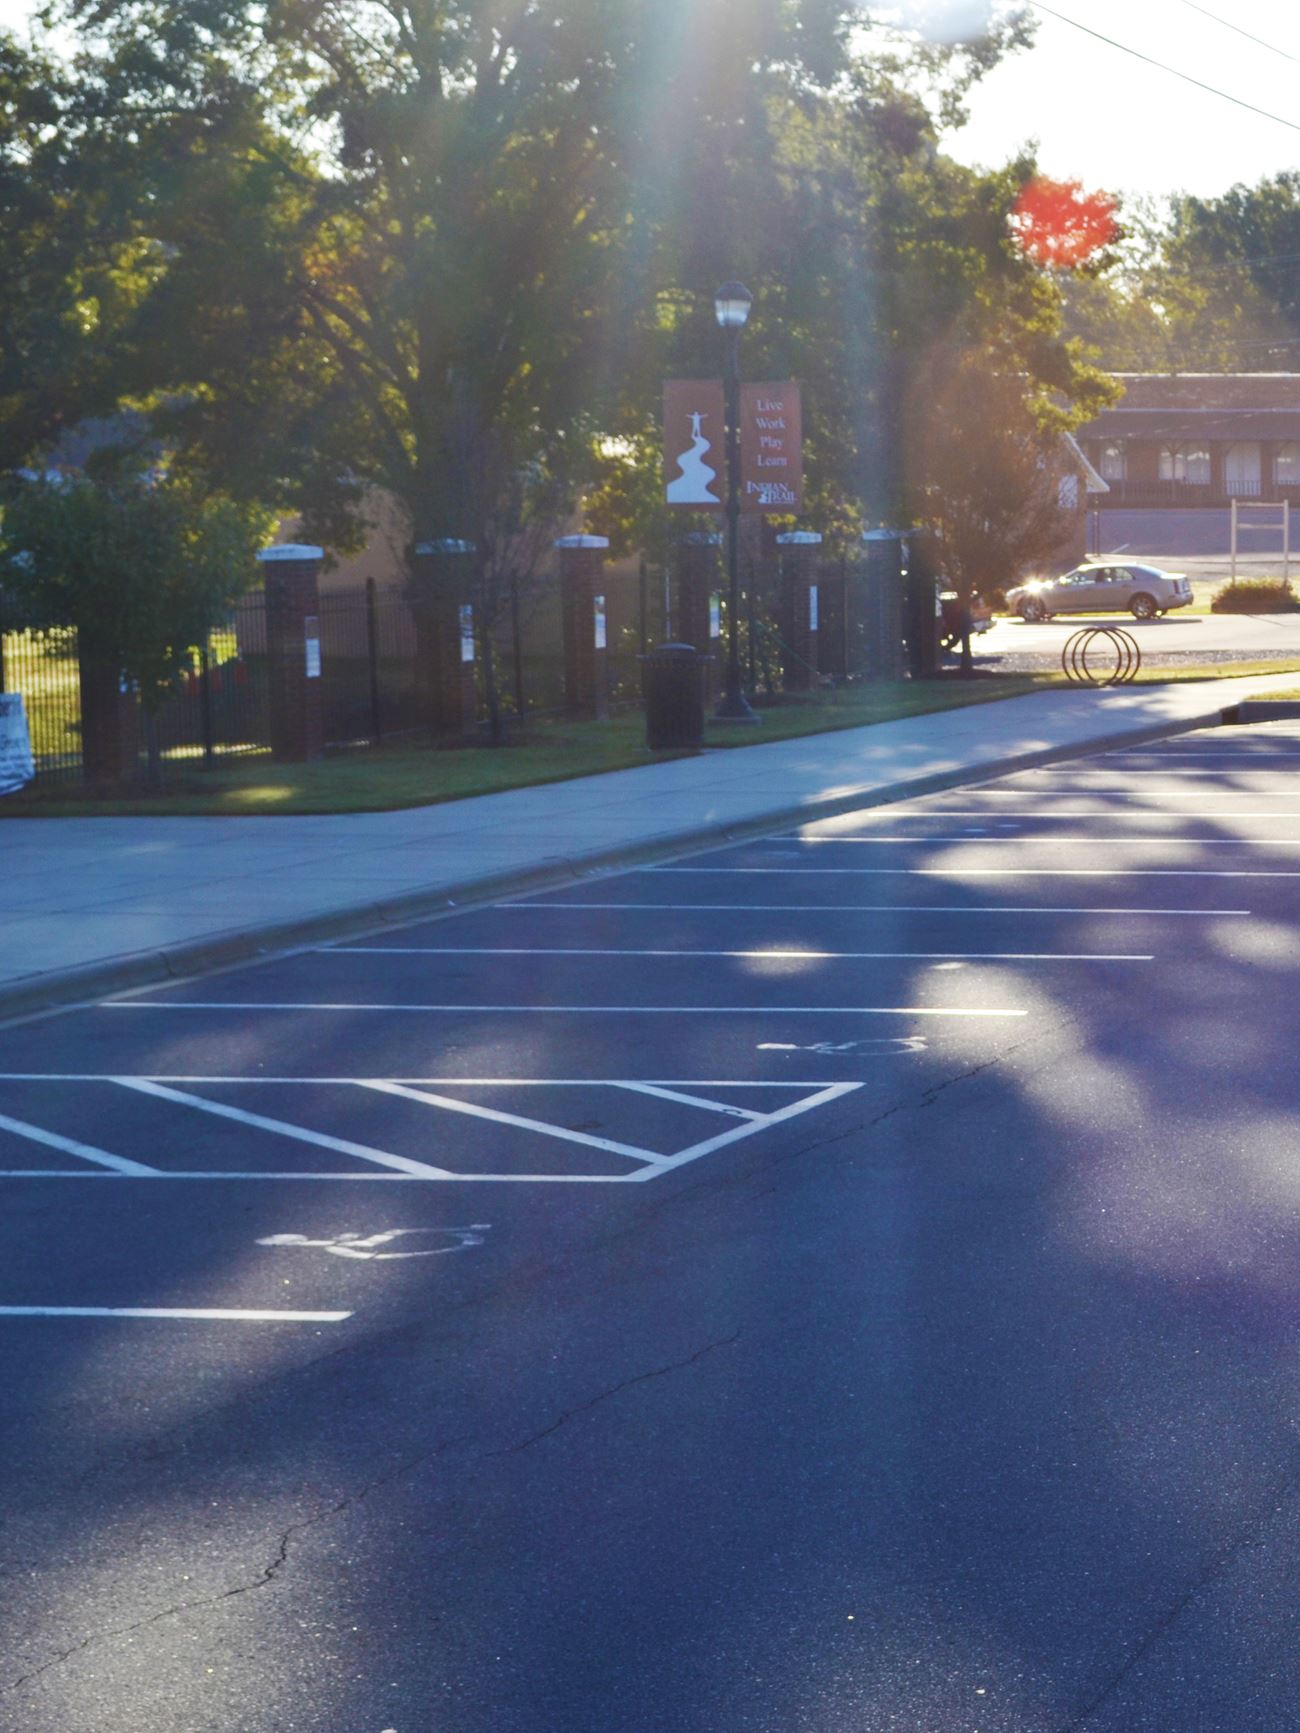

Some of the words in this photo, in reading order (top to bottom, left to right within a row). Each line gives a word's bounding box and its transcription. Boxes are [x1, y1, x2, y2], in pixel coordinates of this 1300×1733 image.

[757, 400, 784, 411] Live
[756, 417, 785, 429] Work
[760, 436, 783, 450] Play
[757, 454, 787, 466] Learn
